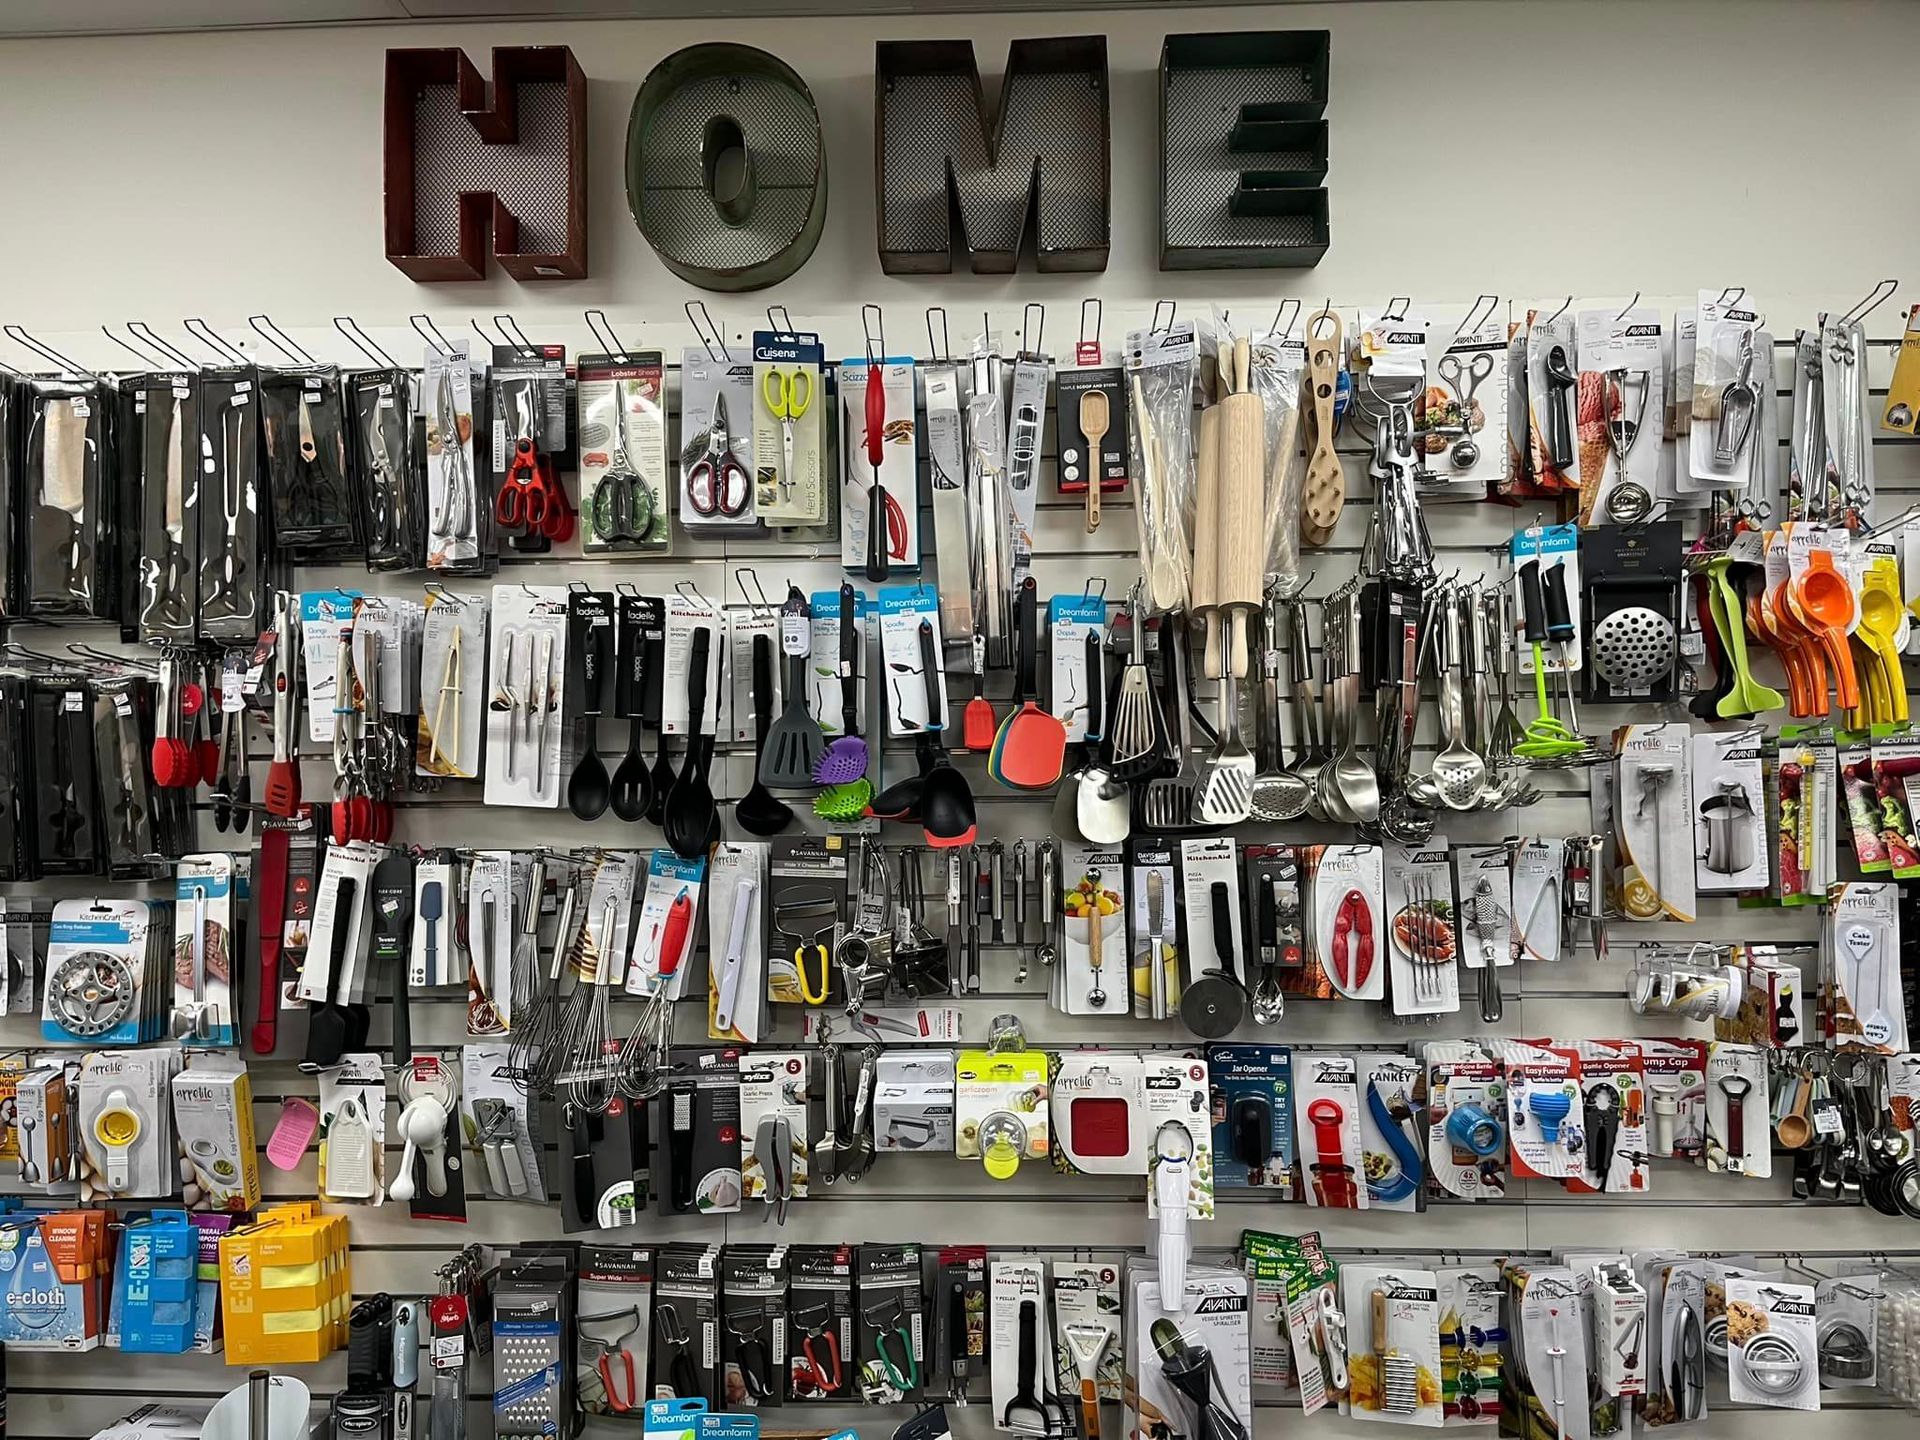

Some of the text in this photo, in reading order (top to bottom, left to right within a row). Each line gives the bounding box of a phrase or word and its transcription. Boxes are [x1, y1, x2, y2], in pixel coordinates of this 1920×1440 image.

[383, 30, 1330, 292] HOME
[1728, 310, 1753, 321] AVANTI
[1626, 325, 1657, 336] AVANTI
[1165, 335, 1190, 345] AVANTI
[1388, 332, 1420, 343] AVANTI
[1453, 335, 1483, 345] AVANTI
[449, 354, 467, 364] GEFU
[806, 450, 816, 516] Herb Scissors
[1867, 544, 1893, 554] AVANTI
[885, 597, 931, 608] Dreamfarm
[576, 607, 605, 617] ladelle
[627, 611, 656, 622] ladelle
[670, 610, 713, 618] KitchenAid
[784, 609, 801, 617] Zeal
[1058, 608, 1099, 618] Dreamfarm
[735, 623, 775, 631] KitchenAid
[585, 653, 595, 680] ladelle
[633, 656, 643, 683] ladelle
[1625, 738, 1662, 750] appetito
[1726, 749, 1757, 759] AVANTI
[329, 851, 366, 863] KitchenAid
[418, 856, 440, 866] Zeal
[1092, 855, 1119, 864] AVANTI
[1186, 854, 1231, 862] KitchenAid
[1416, 852, 1444, 863] AVANTI
[655, 860, 696, 875] Dreamfarm
[1841, 895, 1877, 908] appetito
[79, 913, 121, 923] KitchenCraft
[1852, 931, 1870, 940] Cake
[1849, 939, 1871, 948] Tester
[790, 1061, 798, 1071] 5
[1603, 1063, 1630, 1072] Opener
[1669, 1056, 1688, 1069] Cap
[90, 1062, 123, 1075] appetito
[339, 1069, 362, 1077] AVANTI
[1193, 1068, 1200, 1078] 5
[1232, 1065, 1268, 1075] Jar Opener
[1525, 1066, 1568, 1078] Easy Funnel
[148, 1060, 156, 1098] Egg Separator
[1319, 1073, 1350, 1083] AVANTI
[1369, 1071, 1411, 1082] CANKEY
[1058, 1075, 1093, 1089] appetito
[176, 1088, 213, 1100] appetito
[959, 1085, 998, 1095] garliczoom
[36, 1088, 44, 1122] Egg Topper
[925, 1106, 949, 1114] AVANTI
[515, 1097, 533, 1156] opener
[228, 1122, 238, 1156] Egg Cutter
[1463, 1171, 1473, 1179] 4x
[52, 1227, 78, 1235] WINDOW
[127, 1235, 152, 1301] E-CLH
[598, 1262, 637, 1270] SAVANNAH
[1258, 1260, 1277, 1268] French
[1104, 1271, 1111, 1280] 5
[1258, 1267, 1276, 1275] Bean
[228, 1242, 253, 1313] E-CLH
[590, 1274, 607, 1282] Super
[6, 1288, 65, 1305] e-cloth
[1392, 1289, 1431, 1300] AVANTI
[1201, 1298, 1241, 1311] AVANTI
[1773, 1302, 1810, 1314] AVANTI
[1429, 1320, 1441, 1364] cutter
[344, 1419, 373, 1428] Microplane
[702, 1427, 752, 1438] Dreamfarm
